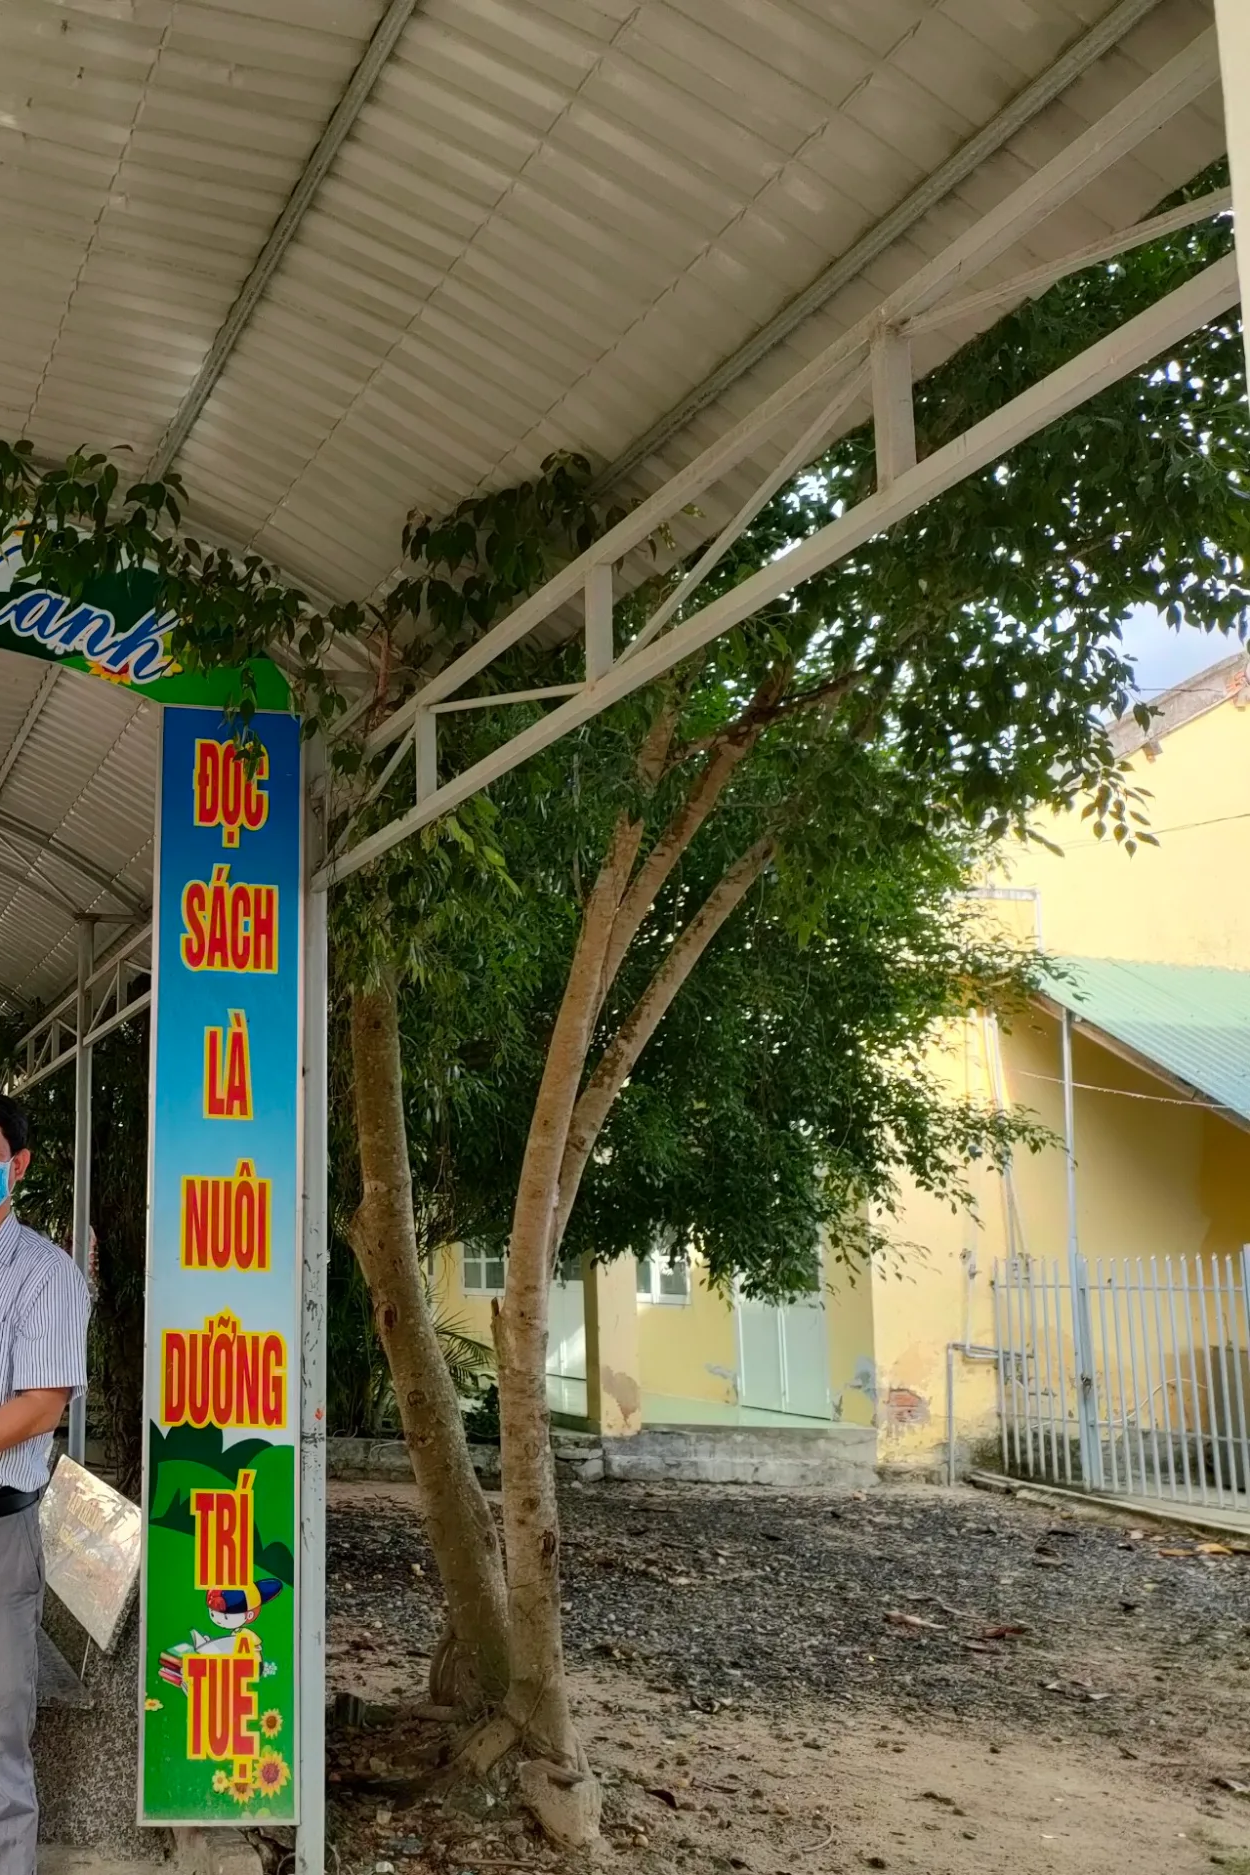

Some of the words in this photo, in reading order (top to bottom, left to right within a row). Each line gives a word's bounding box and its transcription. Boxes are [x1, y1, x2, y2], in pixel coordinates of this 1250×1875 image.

[192, 738, 269, 848] ĐỌC
[181, 863, 278, 974] SÁCH
[204, 1009, 253, 1120] LÀ
[181, 1157, 271, 1270] NUÔI
[161, 1307, 286, 1429] DƯỠNG
[190, 1469, 256, 1589] TRÍ
[183, 1632, 258, 1783] TUỆ
